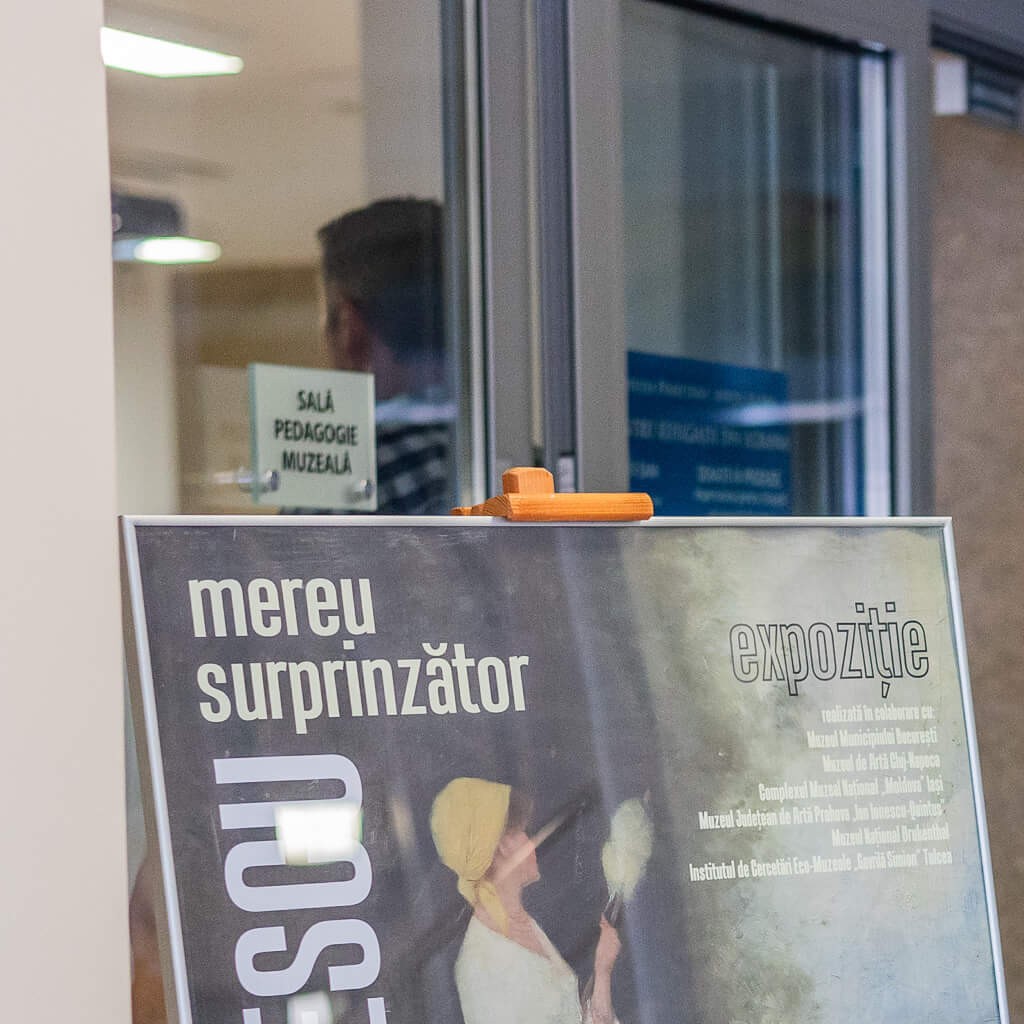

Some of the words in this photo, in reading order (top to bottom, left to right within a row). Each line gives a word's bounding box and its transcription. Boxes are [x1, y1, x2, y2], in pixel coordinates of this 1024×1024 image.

[274, 418, 358, 447] PEDAGOGIE
[188, 577, 377, 638] mereu
[729, 601, 930, 698] expoziție
[196, 639, 530, 735] surprinzător
[759, 781, 808, 803] Complexul
[698, 809, 735, 830] Muzeul
[779, 806, 792, 825] de
[689, 860, 736, 882] Institutul
[737, 859, 750, 878] de
[750, 857, 792, 878] Cercetări
